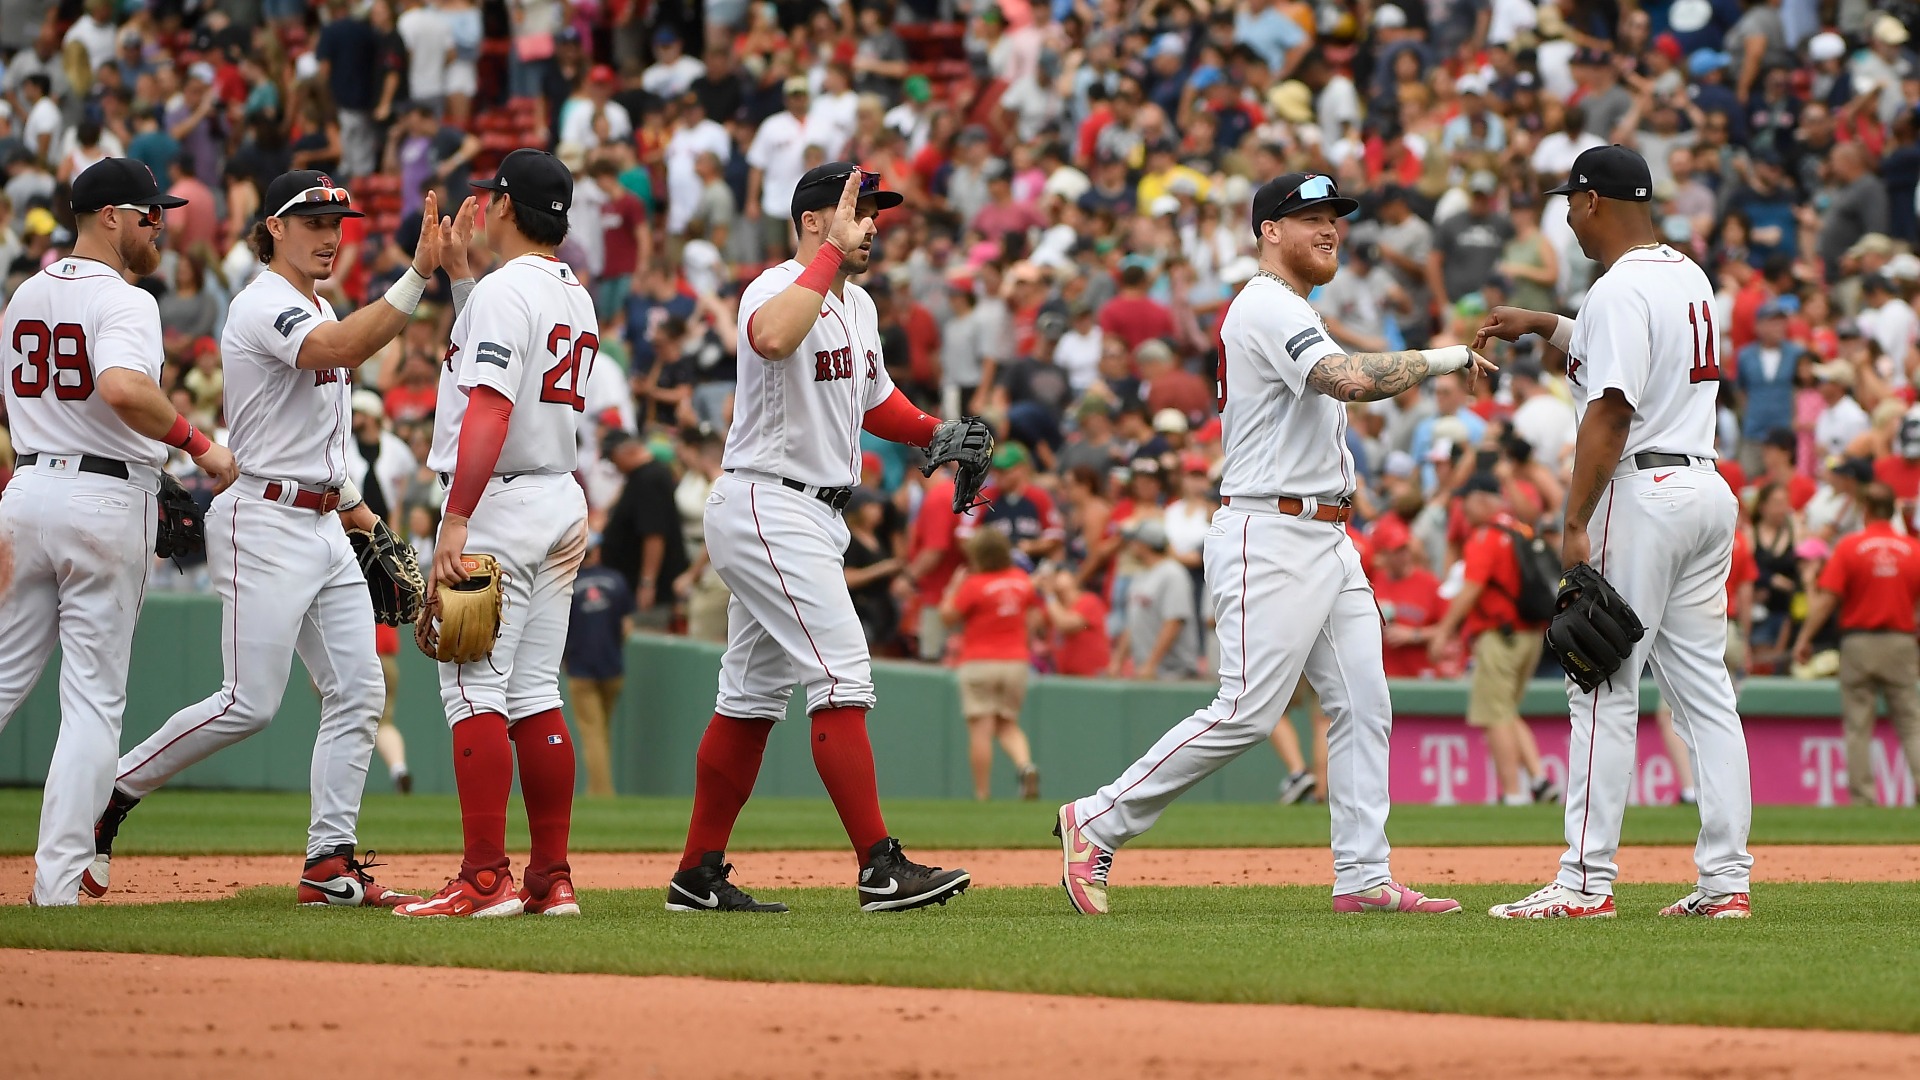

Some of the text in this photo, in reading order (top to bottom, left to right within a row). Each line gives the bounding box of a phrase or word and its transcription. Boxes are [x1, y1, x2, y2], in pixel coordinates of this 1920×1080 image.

[12, 320, 95, 401] 39
[539, 322, 600, 413] 20
[1688, 300, 1720, 385] 11
